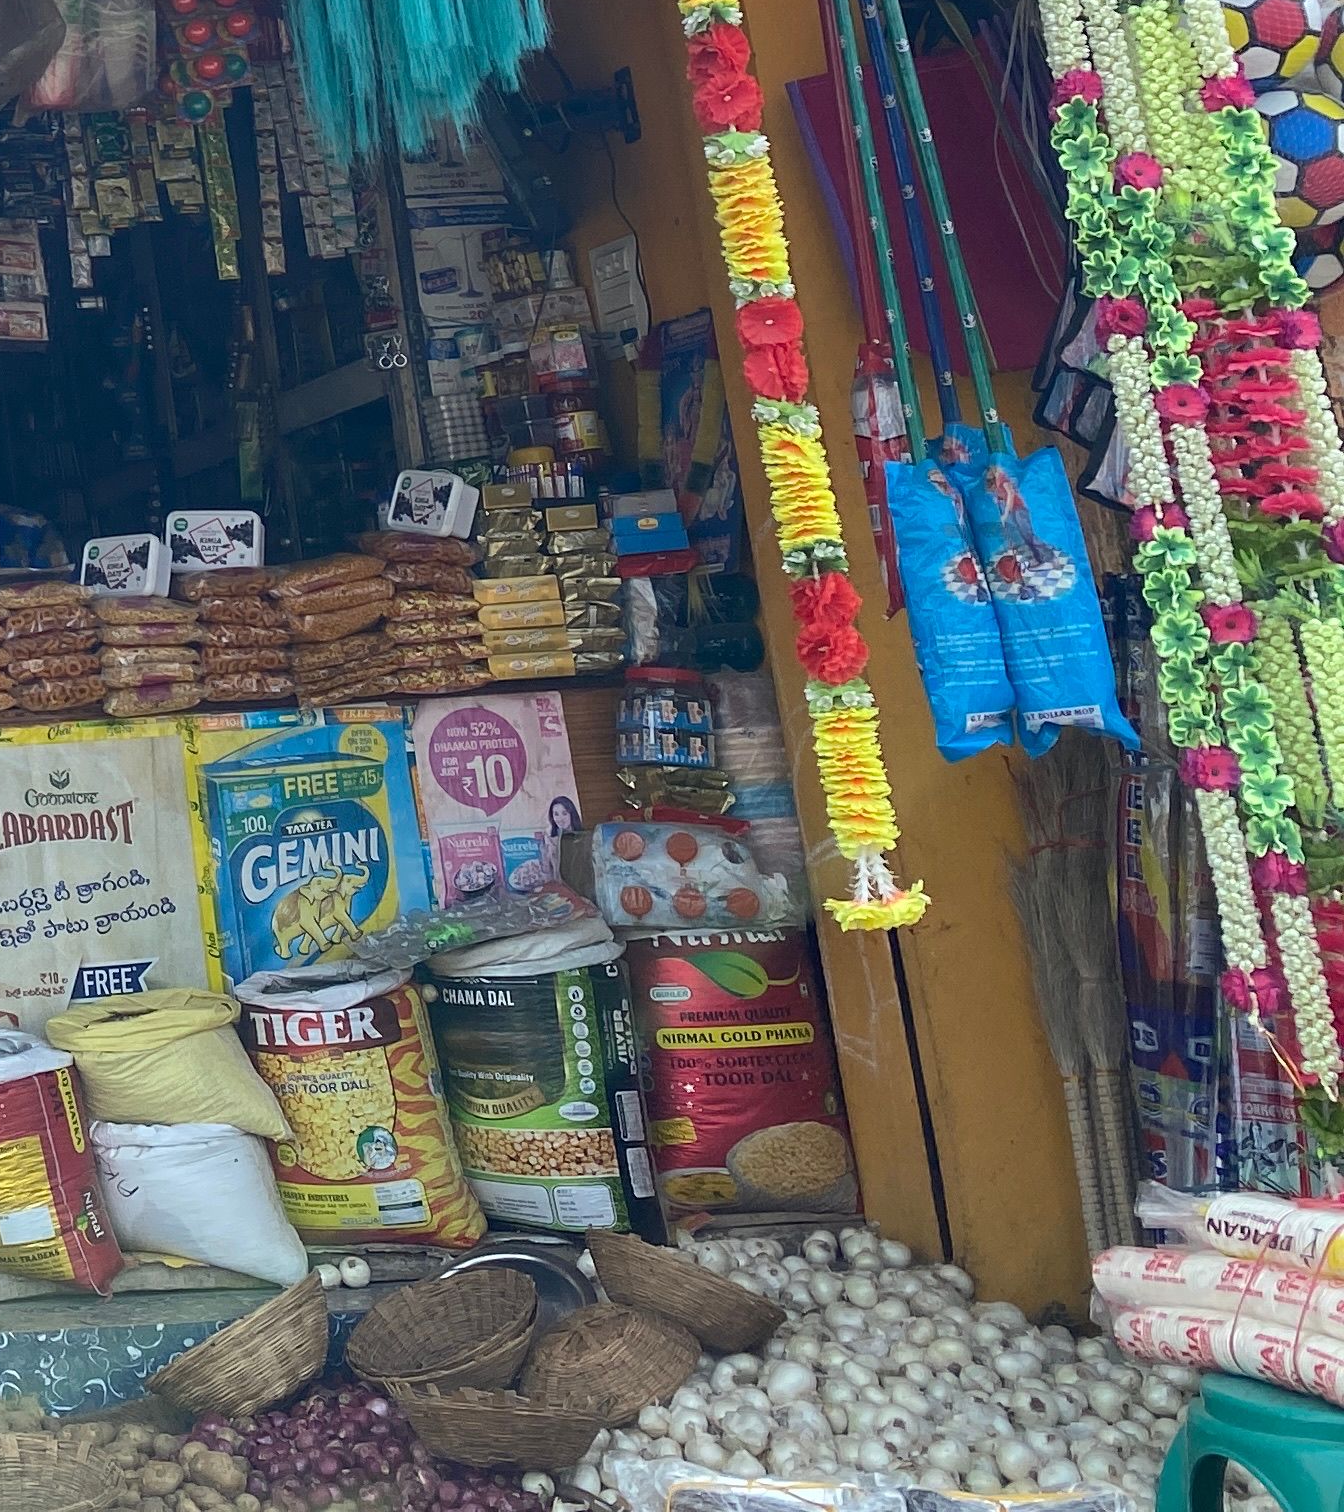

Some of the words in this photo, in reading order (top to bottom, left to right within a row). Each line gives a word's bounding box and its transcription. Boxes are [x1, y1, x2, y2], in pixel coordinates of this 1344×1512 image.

[1038, 709, 1073, 721] DOLLAR
[446, 726, 469, 738] NOW
[469, 721, 502, 737] 52%
[433, 739, 478, 754] DHAAKAD
[479, 737, 519, 750] PROTEIN
[439, 765, 460, 778] JUST
[441, 756, 459, 768] FOR
[282, 771, 340, 800] FREE
[461, 753, 515, 799] ₹10
[24, 787, 100, 809] GOODRICKE
[285, 822, 315, 836] TATA
[315, 818, 335, 831] TEA
[240, 827, 381, 905] GEMINI
[53, 879, 71, 902] టీ
[42, 915, 90, 940] పాటు
[82, 967, 133, 997] FREE
[442, 988, 483, 1006] CHANA
[487, 989, 515, 1007] DAL
[679, 1009, 740, 1023] PREMIUM
[744, 1006, 791, 1021] QUALITY
[249, 1005, 383, 1048] TIGER
[662, 1030, 716, 1046] NIRMAL
[720, 1029, 762, 1044] GOLD
[765, 1026, 813, 1042] PHATKA
[611, 1008, 630, 1066] SILVER
[318, 1070, 354, 1081] QUALITY
[494, 1072, 535, 1084] Originality
[702, 1071, 756, 1087] TOOR
[760, 1071, 796, 1086] DAL
[303, 1081, 337, 1094] TOOR
[492, 1094, 537, 1116] QUALITY
[65, 1090, 83, 1147] PHATKA
[1206, 1217, 1295, 1253] DRAGAN
[20, 1249, 61, 1264] TRADERS
